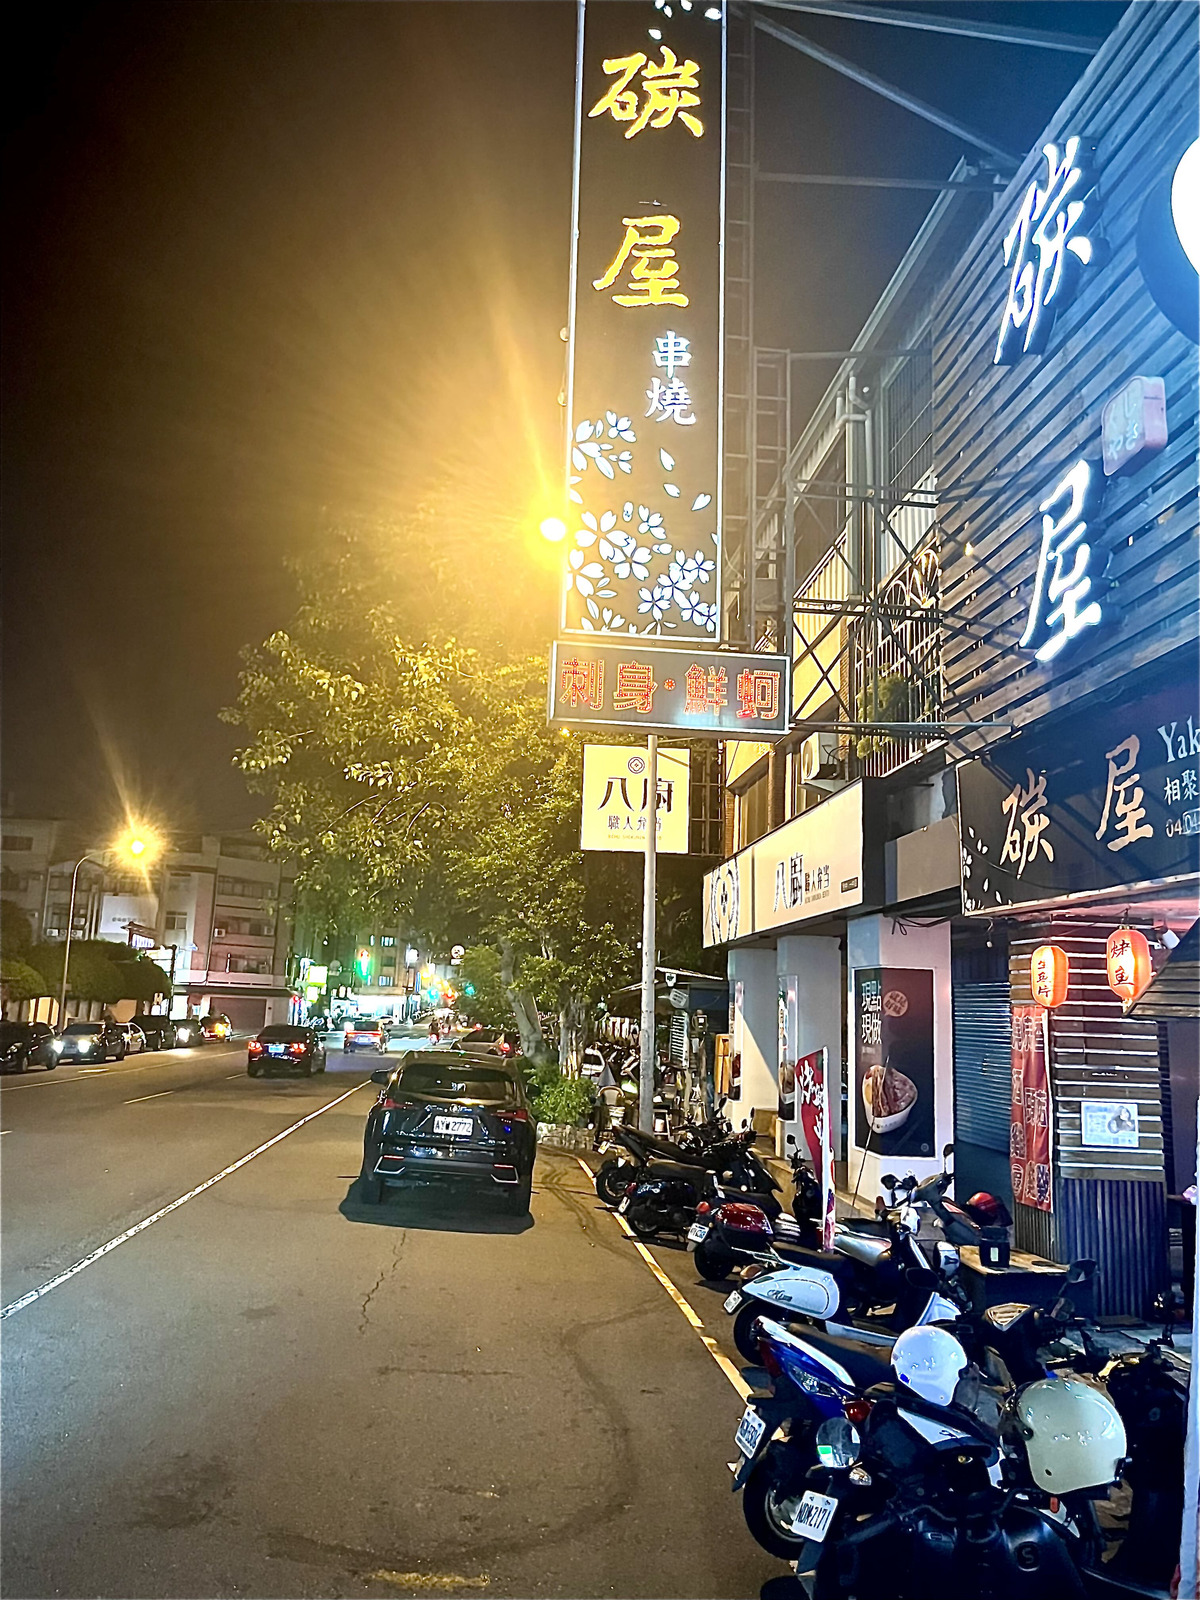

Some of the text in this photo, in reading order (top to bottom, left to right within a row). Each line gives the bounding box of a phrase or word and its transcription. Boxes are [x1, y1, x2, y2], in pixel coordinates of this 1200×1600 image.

[588, 45, 705, 308] 碳屋
[644, 329, 697, 426] 串燒
[1000, 734, 1154, 879] 碳屋
